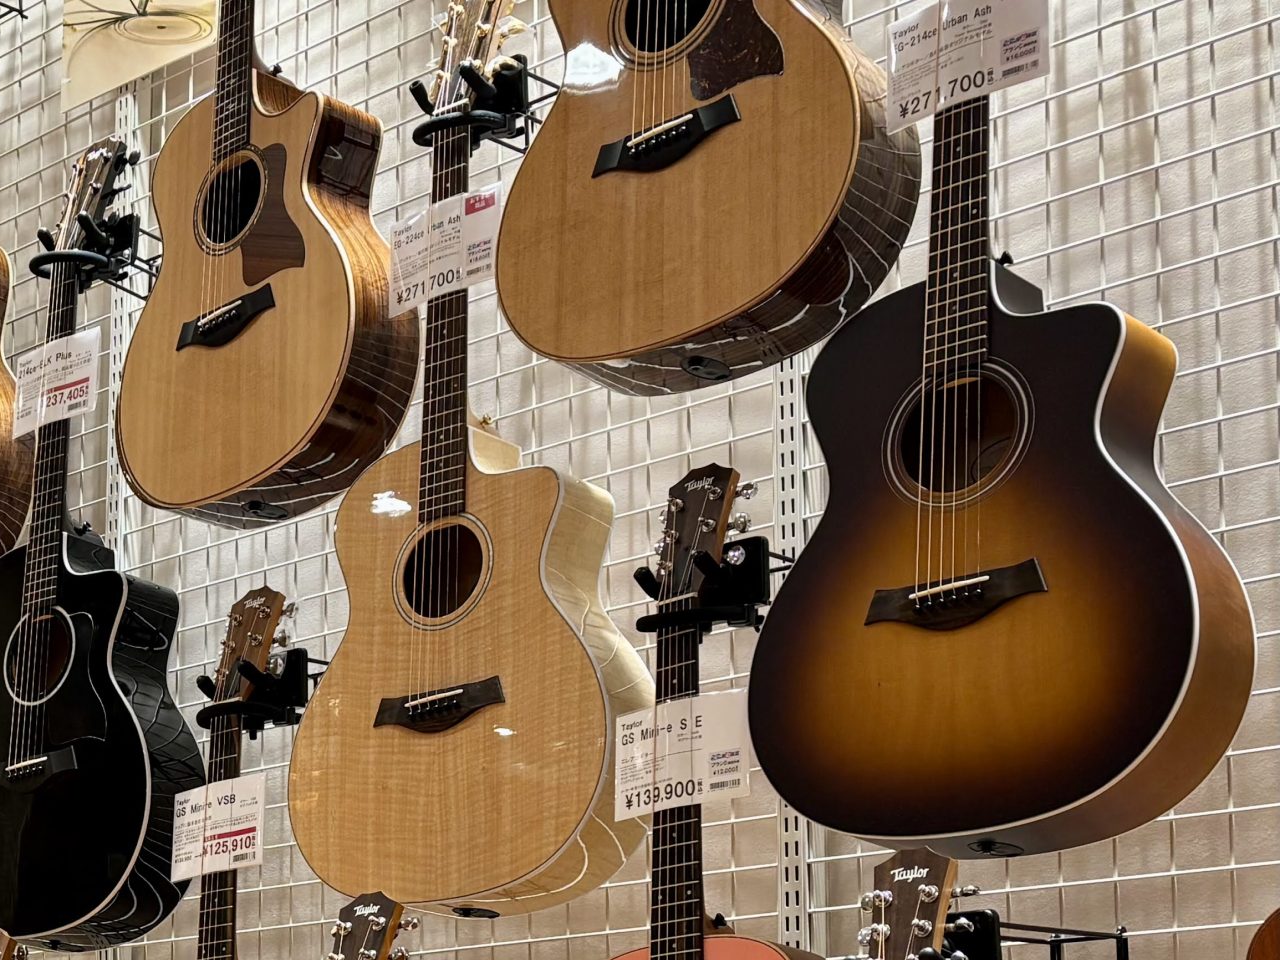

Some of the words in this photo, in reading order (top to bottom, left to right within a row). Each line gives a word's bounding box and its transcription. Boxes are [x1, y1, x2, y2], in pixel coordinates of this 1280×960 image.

[942, 12, 968, 31] Urban
[974, 4, 992, 19] Ash
[397, 269, 455, 305] ¥271700
[45, 385, 85, 407] 237,405
[684, 476, 715, 492] Taylor
[621, 732, 635, 746] GS
[217, 794, 236, 806] VSB
[625, 779, 696, 810] ¥139,900
[890, 865, 929, 882] Taylor
[353, 903, 381, 917] Taylor
